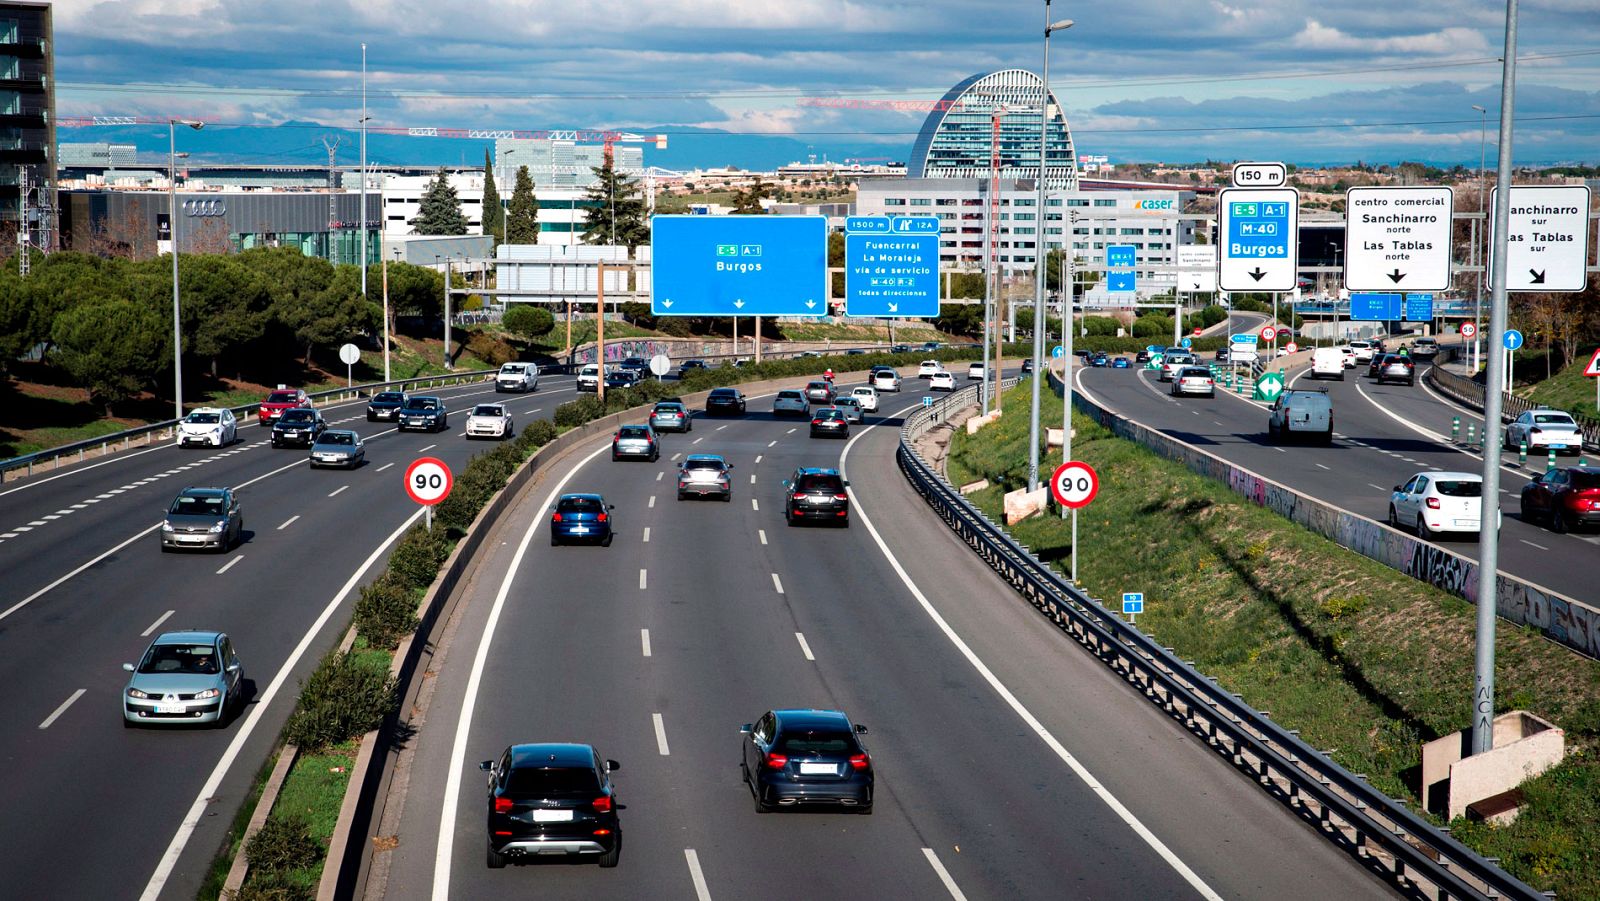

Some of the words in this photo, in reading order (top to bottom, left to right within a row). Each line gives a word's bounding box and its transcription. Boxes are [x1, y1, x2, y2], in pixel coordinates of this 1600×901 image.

[1240, 171, 1261, 180] 150
[1269, 172, 1279, 180] m
[1141, 199, 1173, 210] caser
[1355, 198, 1388, 206] centro
[1394, 197, 1445, 206] comercial
[1234, 204, 1256, 215] E-5
[1265, 204, 1284, 215] A-1
[1510, 205, 1578, 214] anchinarro
[1362, 213, 1437, 223] Sanchinarro
[1241, 223, 1276, 234] M-40
[1386, 225, 1411, 233] norte
[1507, 234, 1524, 242] as
[1532, 232, 1574, 242] Tablas
[865, 241, 920, 250] Fuencarral
[1231, 243, 1285, 257] Burgos
[1363, 240, 1384, 250] Las
[1392, 240, 1433, 250] Tablas
[863, 253, 875, 262] La
[879, 253, 922, 264] Moraleja
[716, 261, 762, 273] Burgos
[415, 474, 442, 489] 90
[1062, 477, 1089, 492] 90
